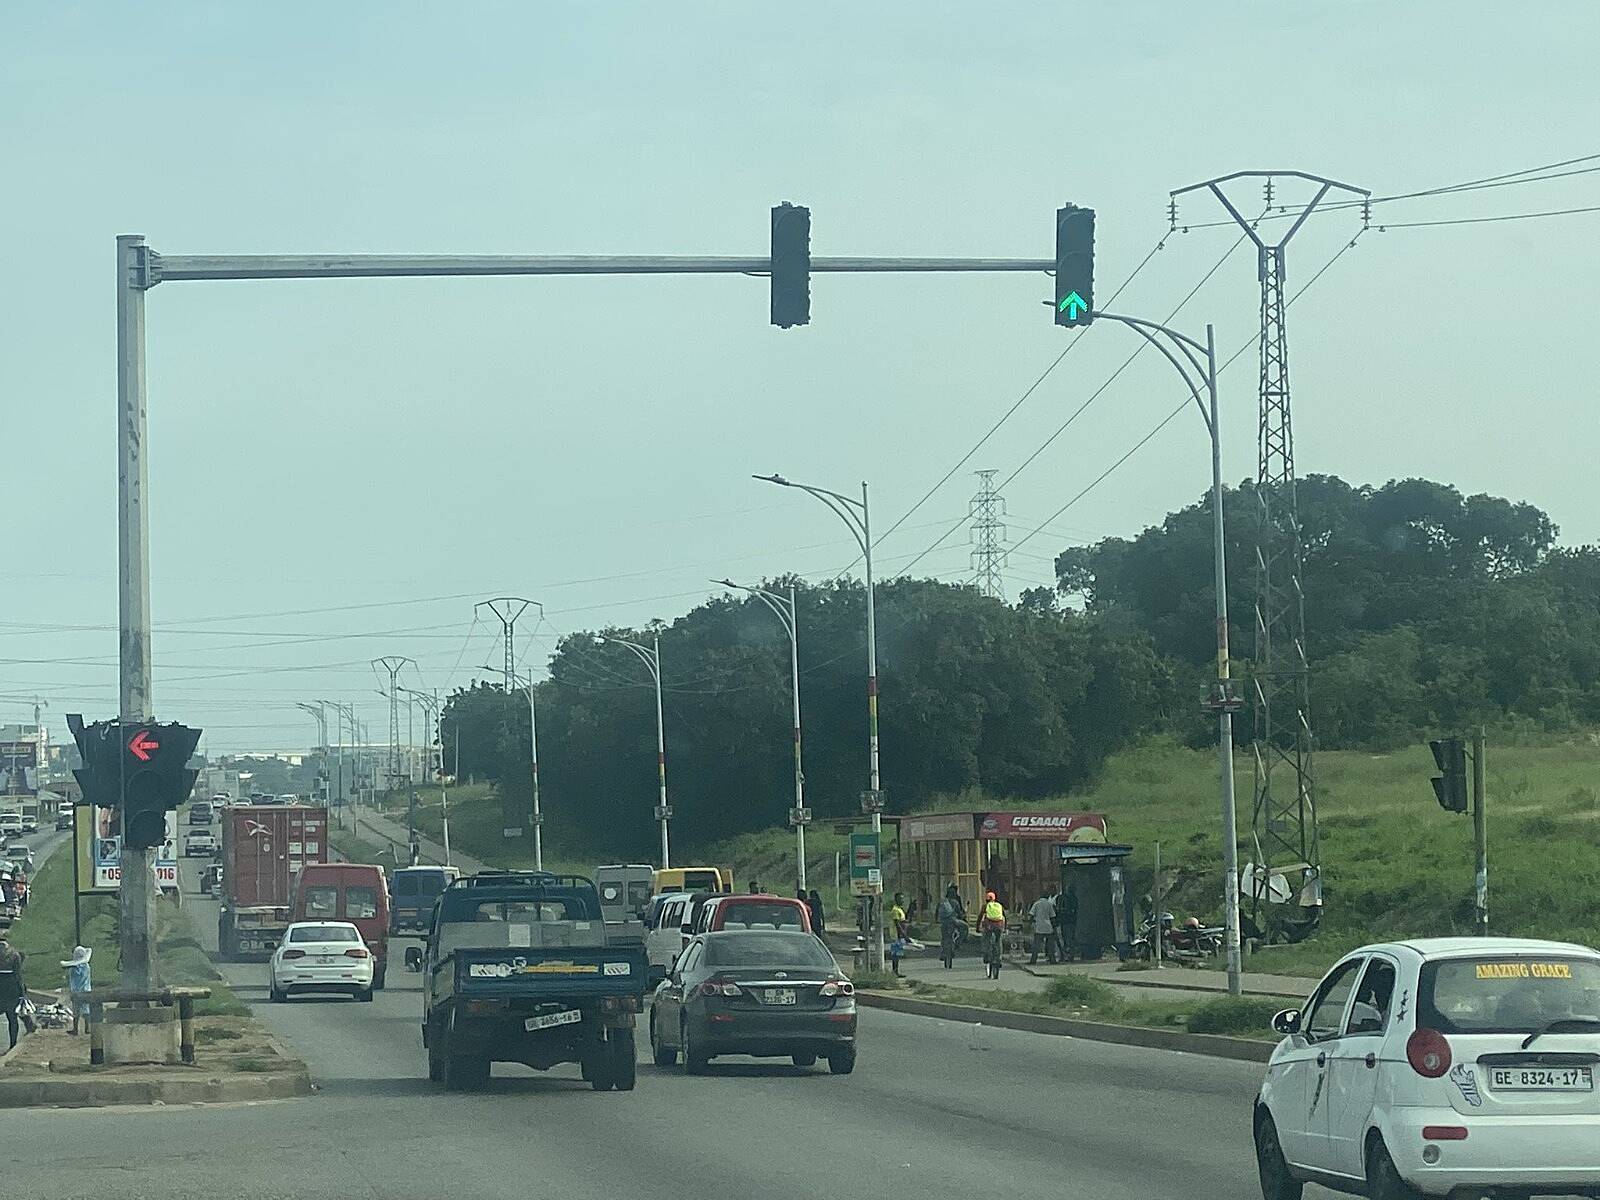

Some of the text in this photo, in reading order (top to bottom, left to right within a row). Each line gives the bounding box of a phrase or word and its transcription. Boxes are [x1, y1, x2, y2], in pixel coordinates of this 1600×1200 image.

[1476, 963, 1572, 978] AMAZING GRACE
[1495, 1071, 1512, 1085] GE
[1521, 1071, 1578, 1085] 8324-17
